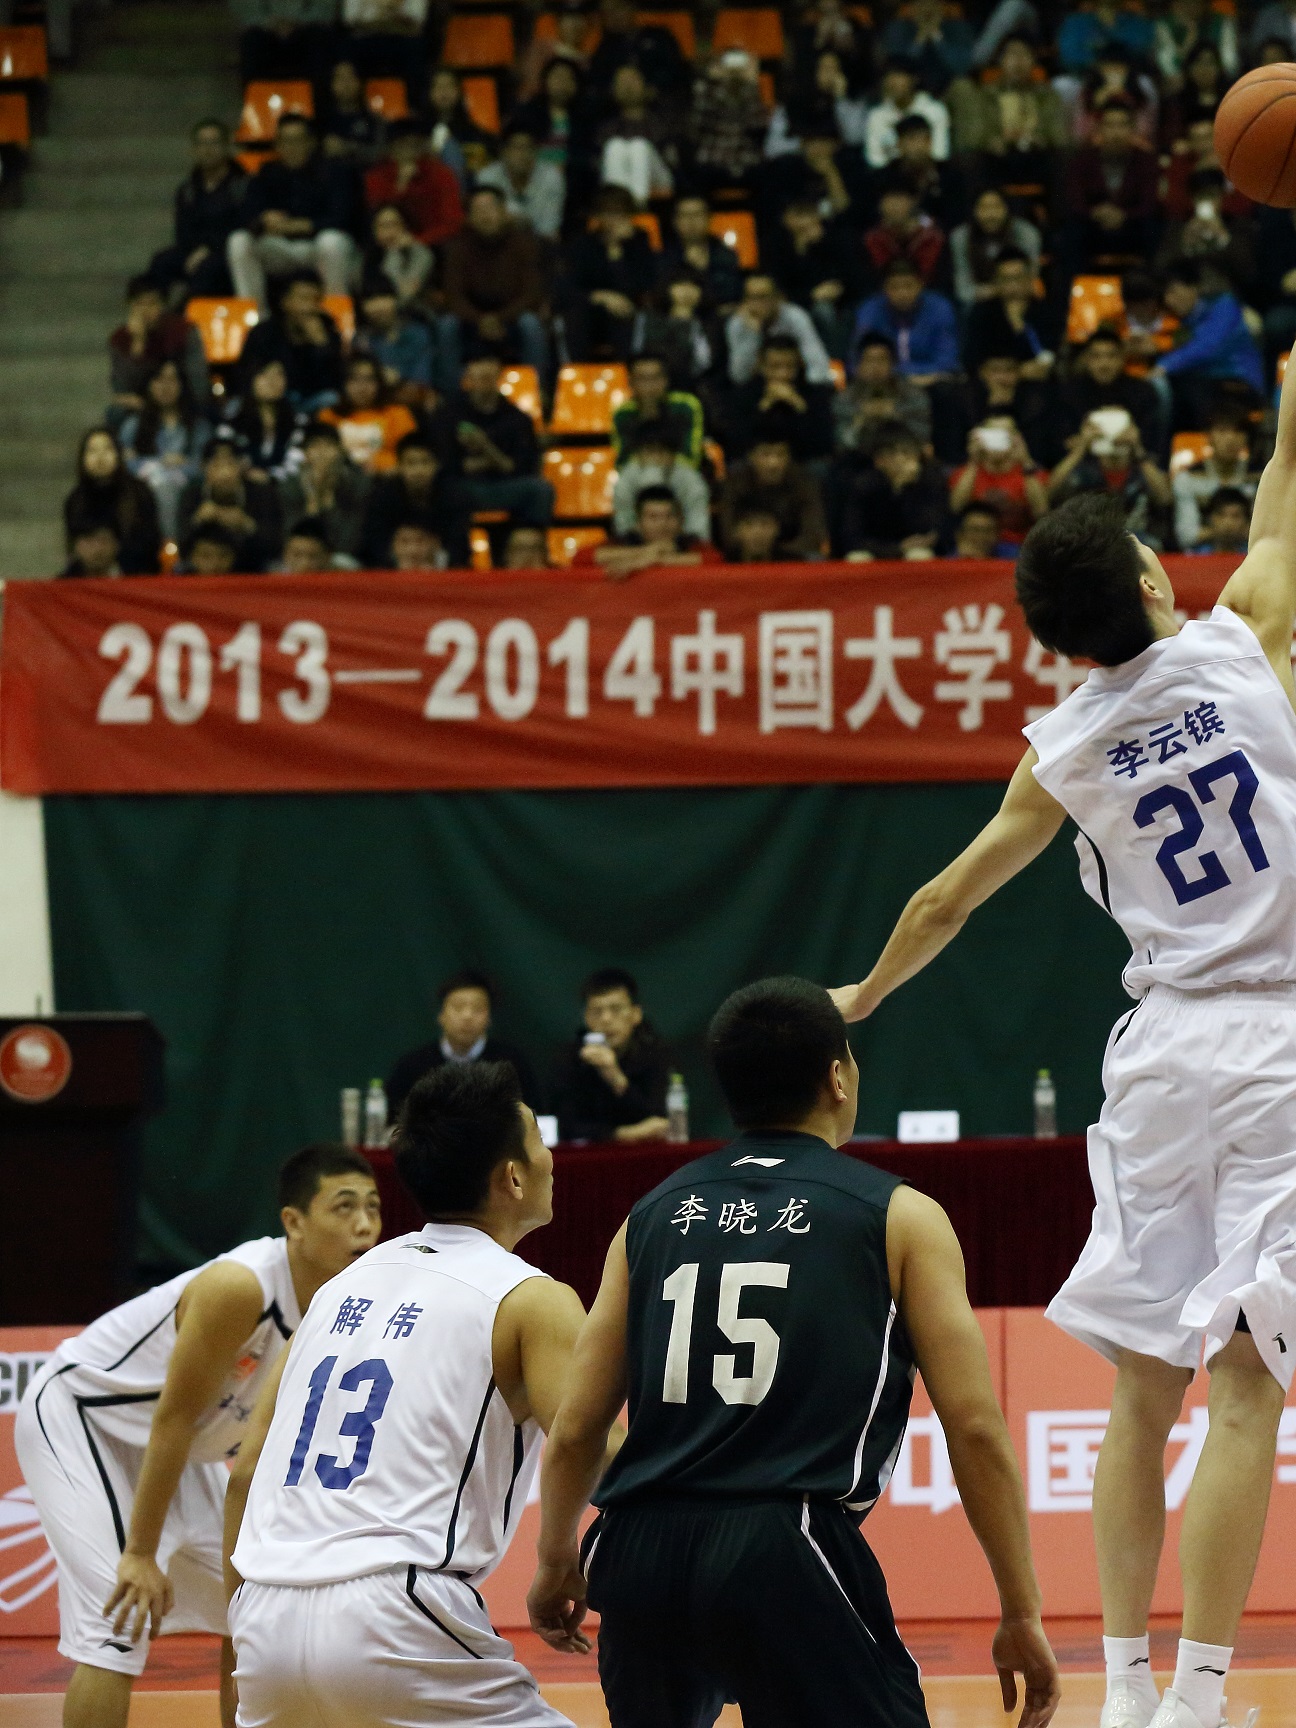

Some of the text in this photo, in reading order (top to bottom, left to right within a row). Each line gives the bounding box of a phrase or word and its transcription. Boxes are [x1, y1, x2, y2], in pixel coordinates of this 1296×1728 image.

[1107, 700, 1226, 781] 李云镔
[1132, 749, 1270, 906] 27
[670, 1194, 811, 1237] 李晓龙
[662, 1261, 792, 1407] 15
[284, 1355, 395, 1491] 13
